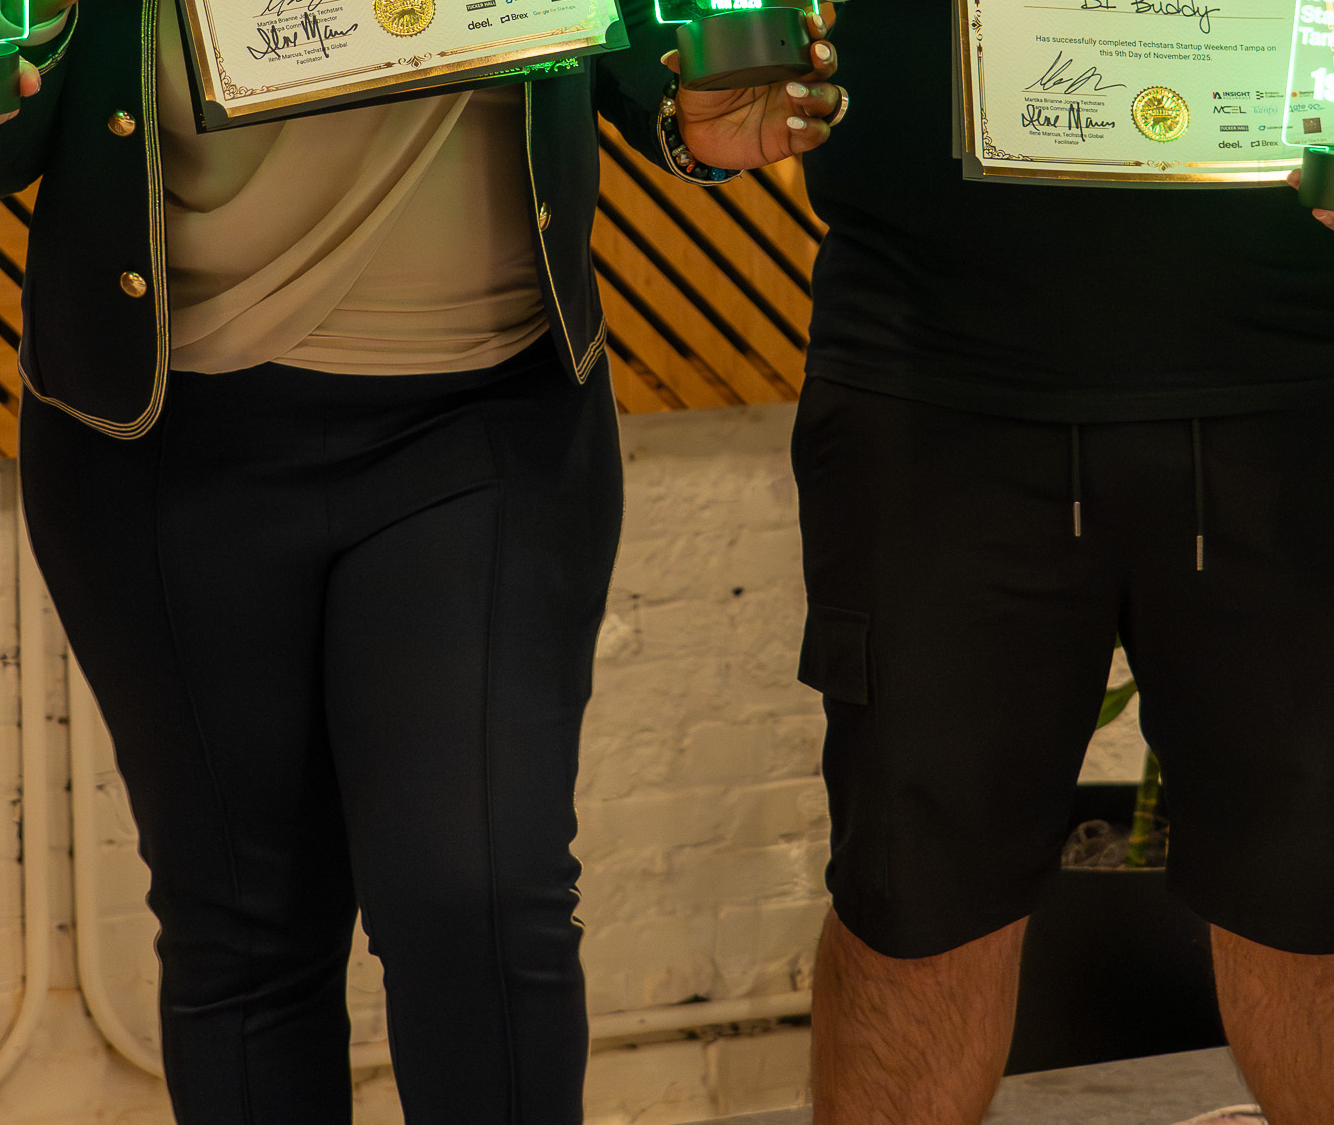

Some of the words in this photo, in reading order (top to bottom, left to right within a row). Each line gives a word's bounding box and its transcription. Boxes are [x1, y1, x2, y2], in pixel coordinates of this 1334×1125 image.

[511, 13, 528, 21] Brex
[467, 18, 493, 30] deel.
[296, 56, 323, 65] Facilitator
